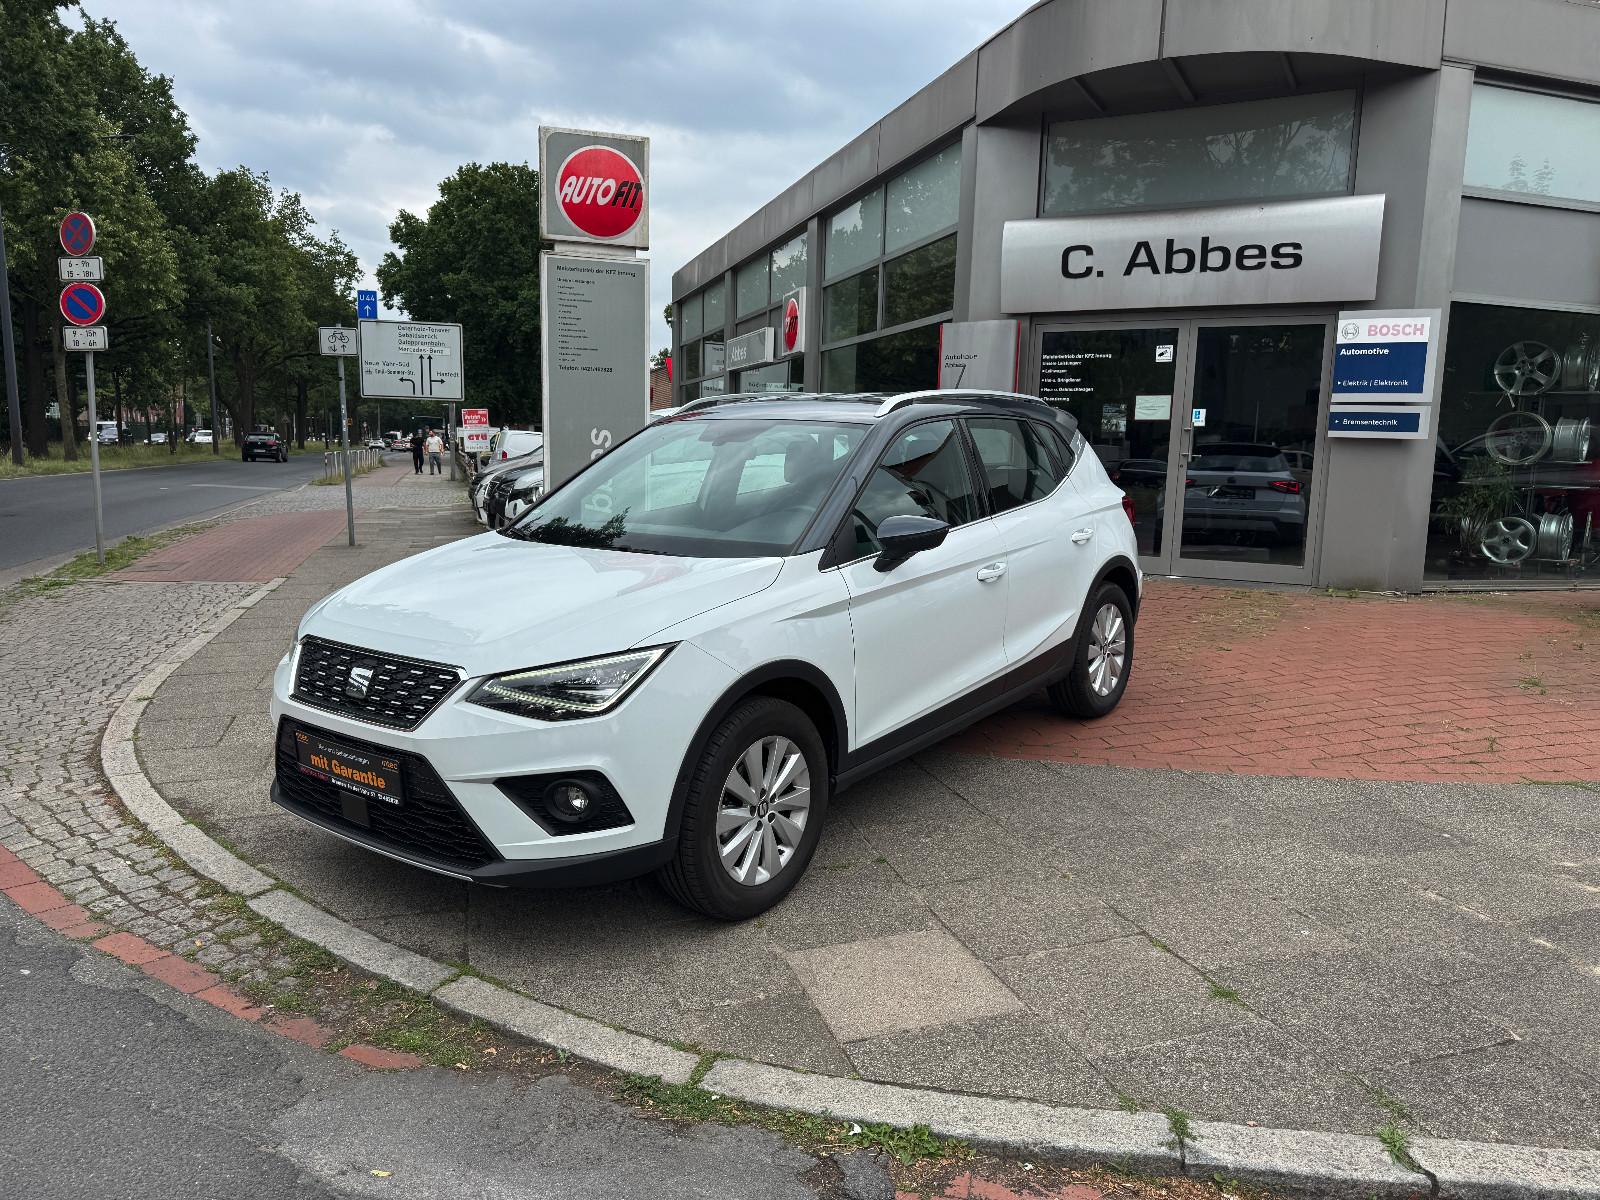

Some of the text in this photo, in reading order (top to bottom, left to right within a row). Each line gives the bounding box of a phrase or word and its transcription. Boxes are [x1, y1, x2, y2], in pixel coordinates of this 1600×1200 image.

[560, 176, 642, 208] AUTOFIT
[1061, 236, 1302, 278] C. Abbes
[1368, 324, 1425, 336] BOSCH
[310, 753, 329, 770] mit
[331, 760, 386, 788] Garantie
